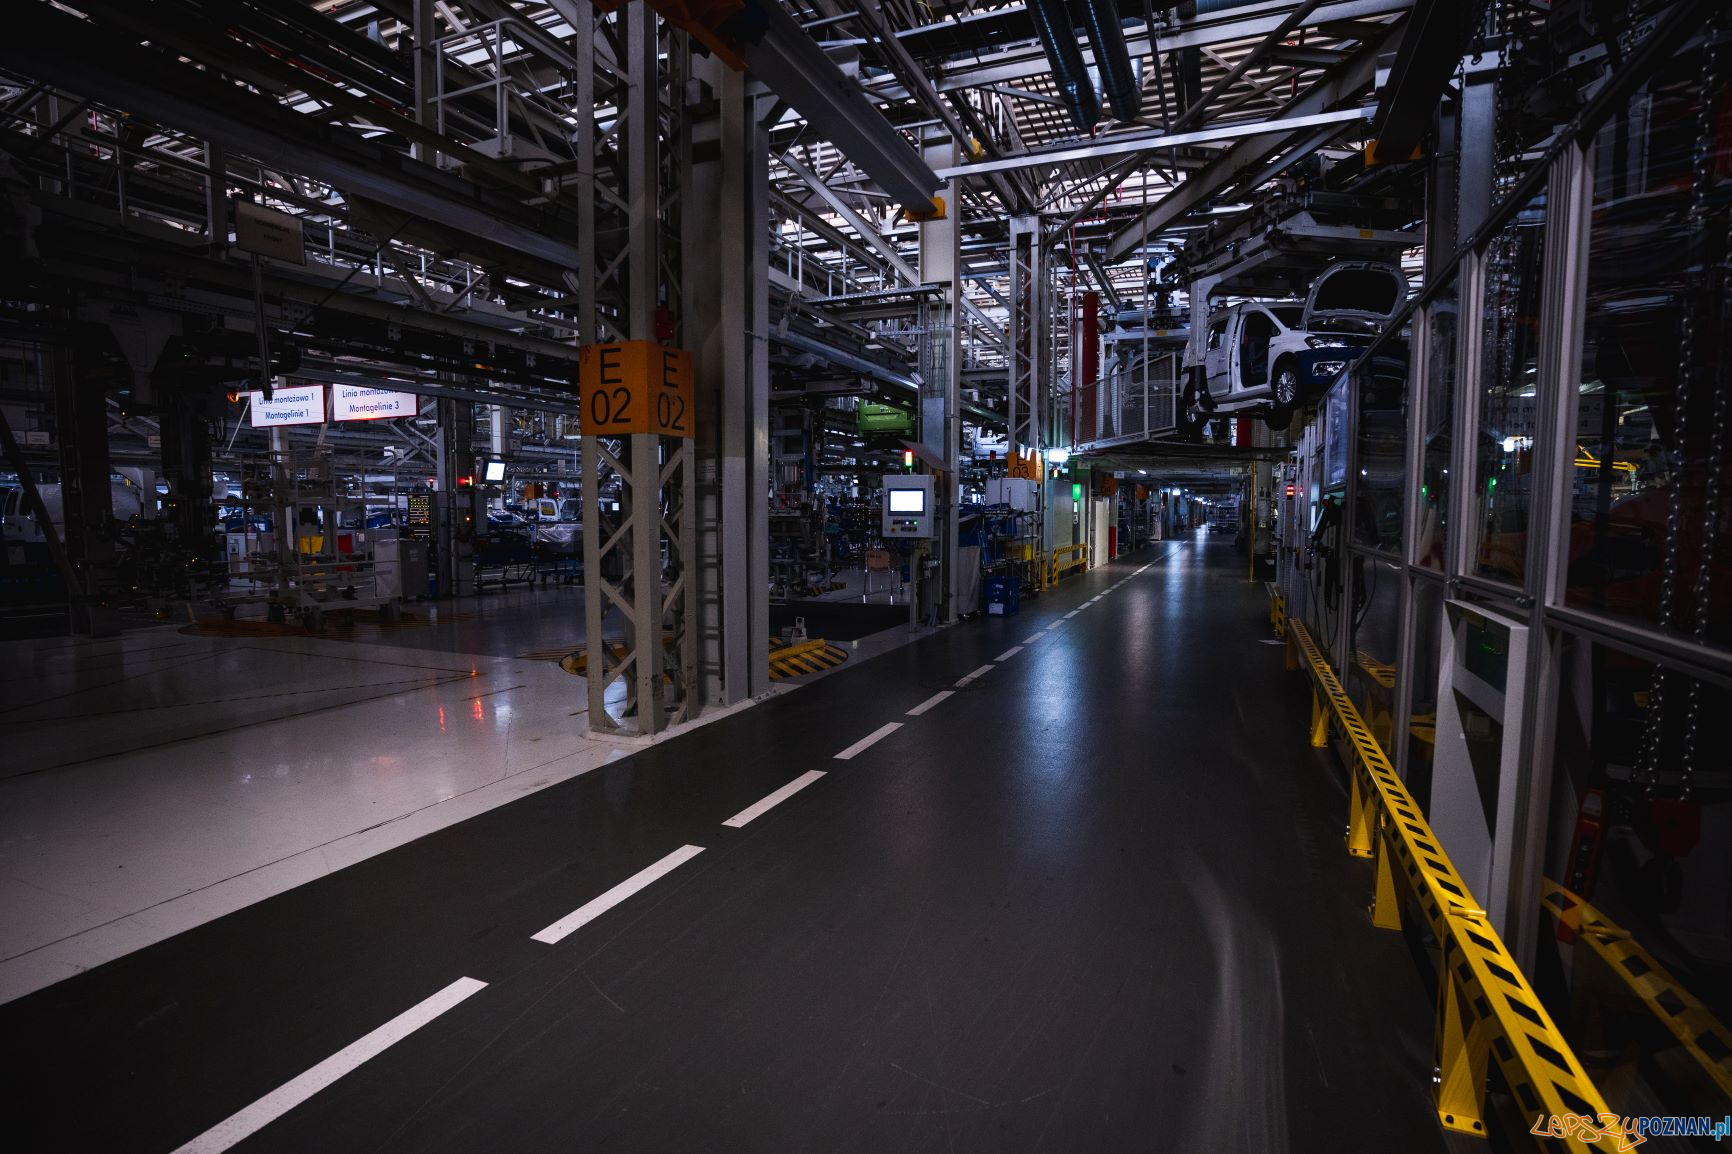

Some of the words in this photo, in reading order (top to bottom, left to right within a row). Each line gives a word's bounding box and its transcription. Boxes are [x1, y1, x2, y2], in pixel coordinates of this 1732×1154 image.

[600, 347, 622, 385] E
[663, 351, 679, 389] E
[274, 394, 309, 404] montażowa
[342, 389, 358, 398] Linia
[349, 401, 393, 414] Montagelinie
[394, 400, 400, 410] 3
[591, 387, 632, 426] 02
[657, 391, 685, 431] 02
[265, 409, 304, 421] Montagelinie
[1013, 466, 1030, 479] 03
